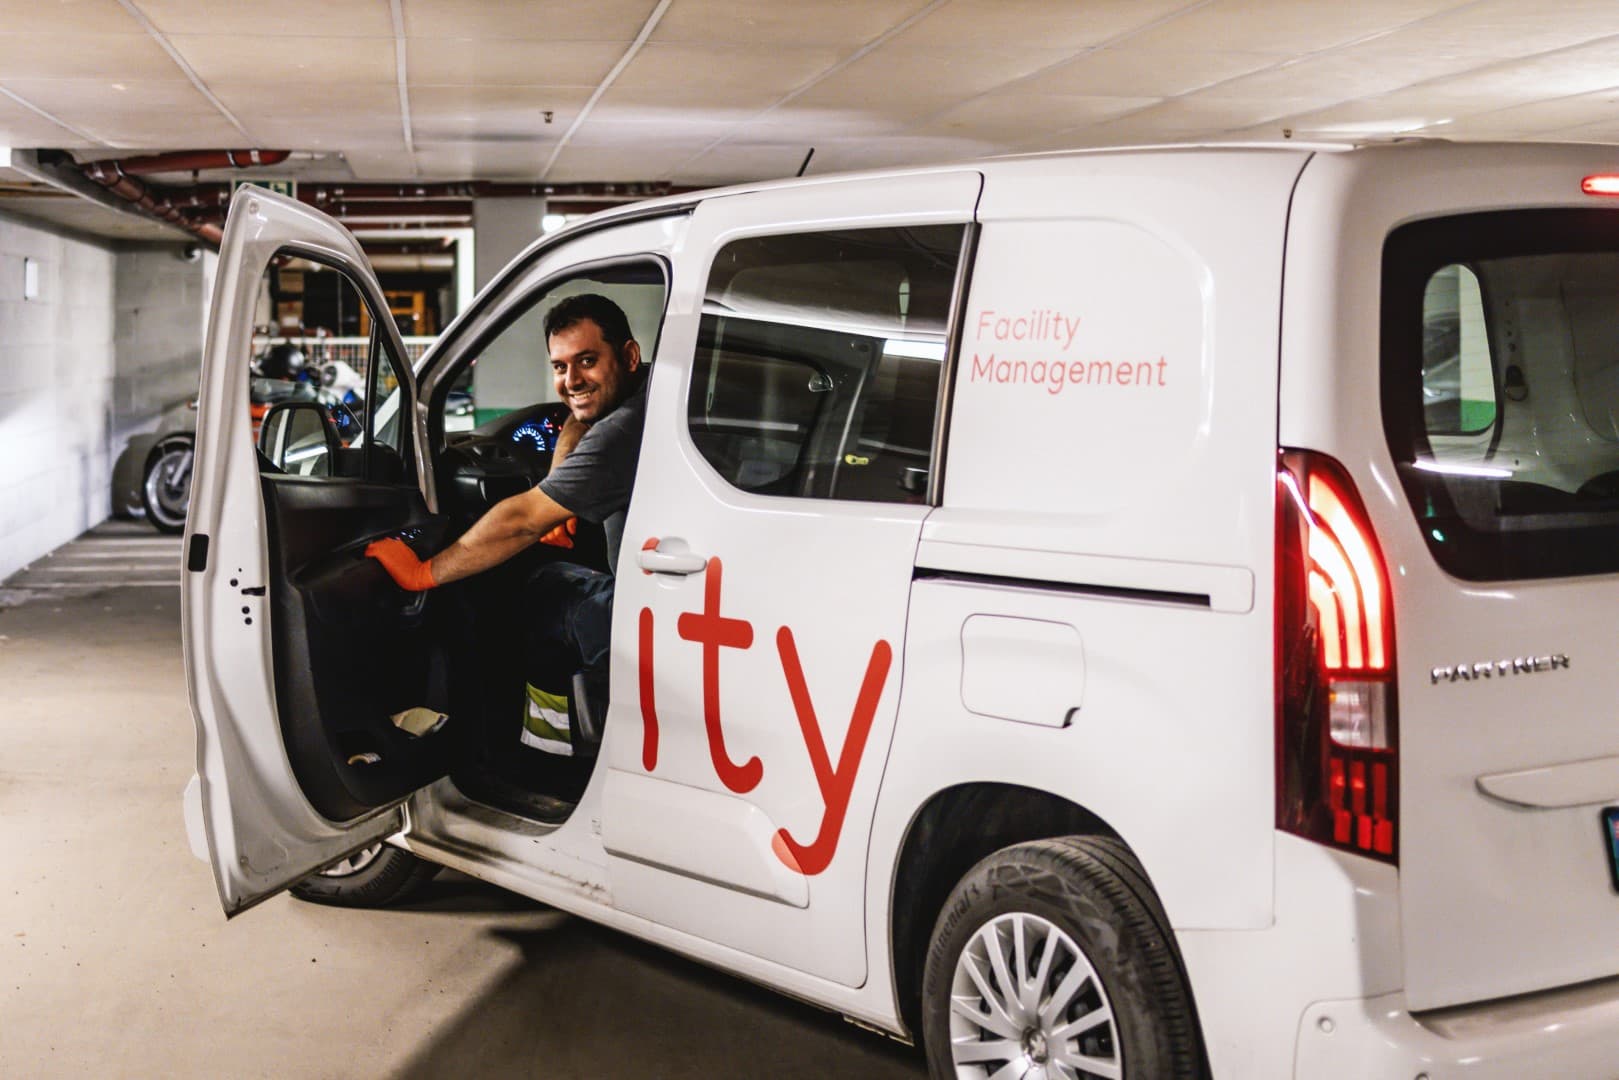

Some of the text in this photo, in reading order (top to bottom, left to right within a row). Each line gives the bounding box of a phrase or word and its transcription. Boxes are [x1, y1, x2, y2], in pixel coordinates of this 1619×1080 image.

[977, 310, 1081, 351] Facility
[970, 353, 1168, 395] Management
[1431, 655, 1570, 684] PARTNER
